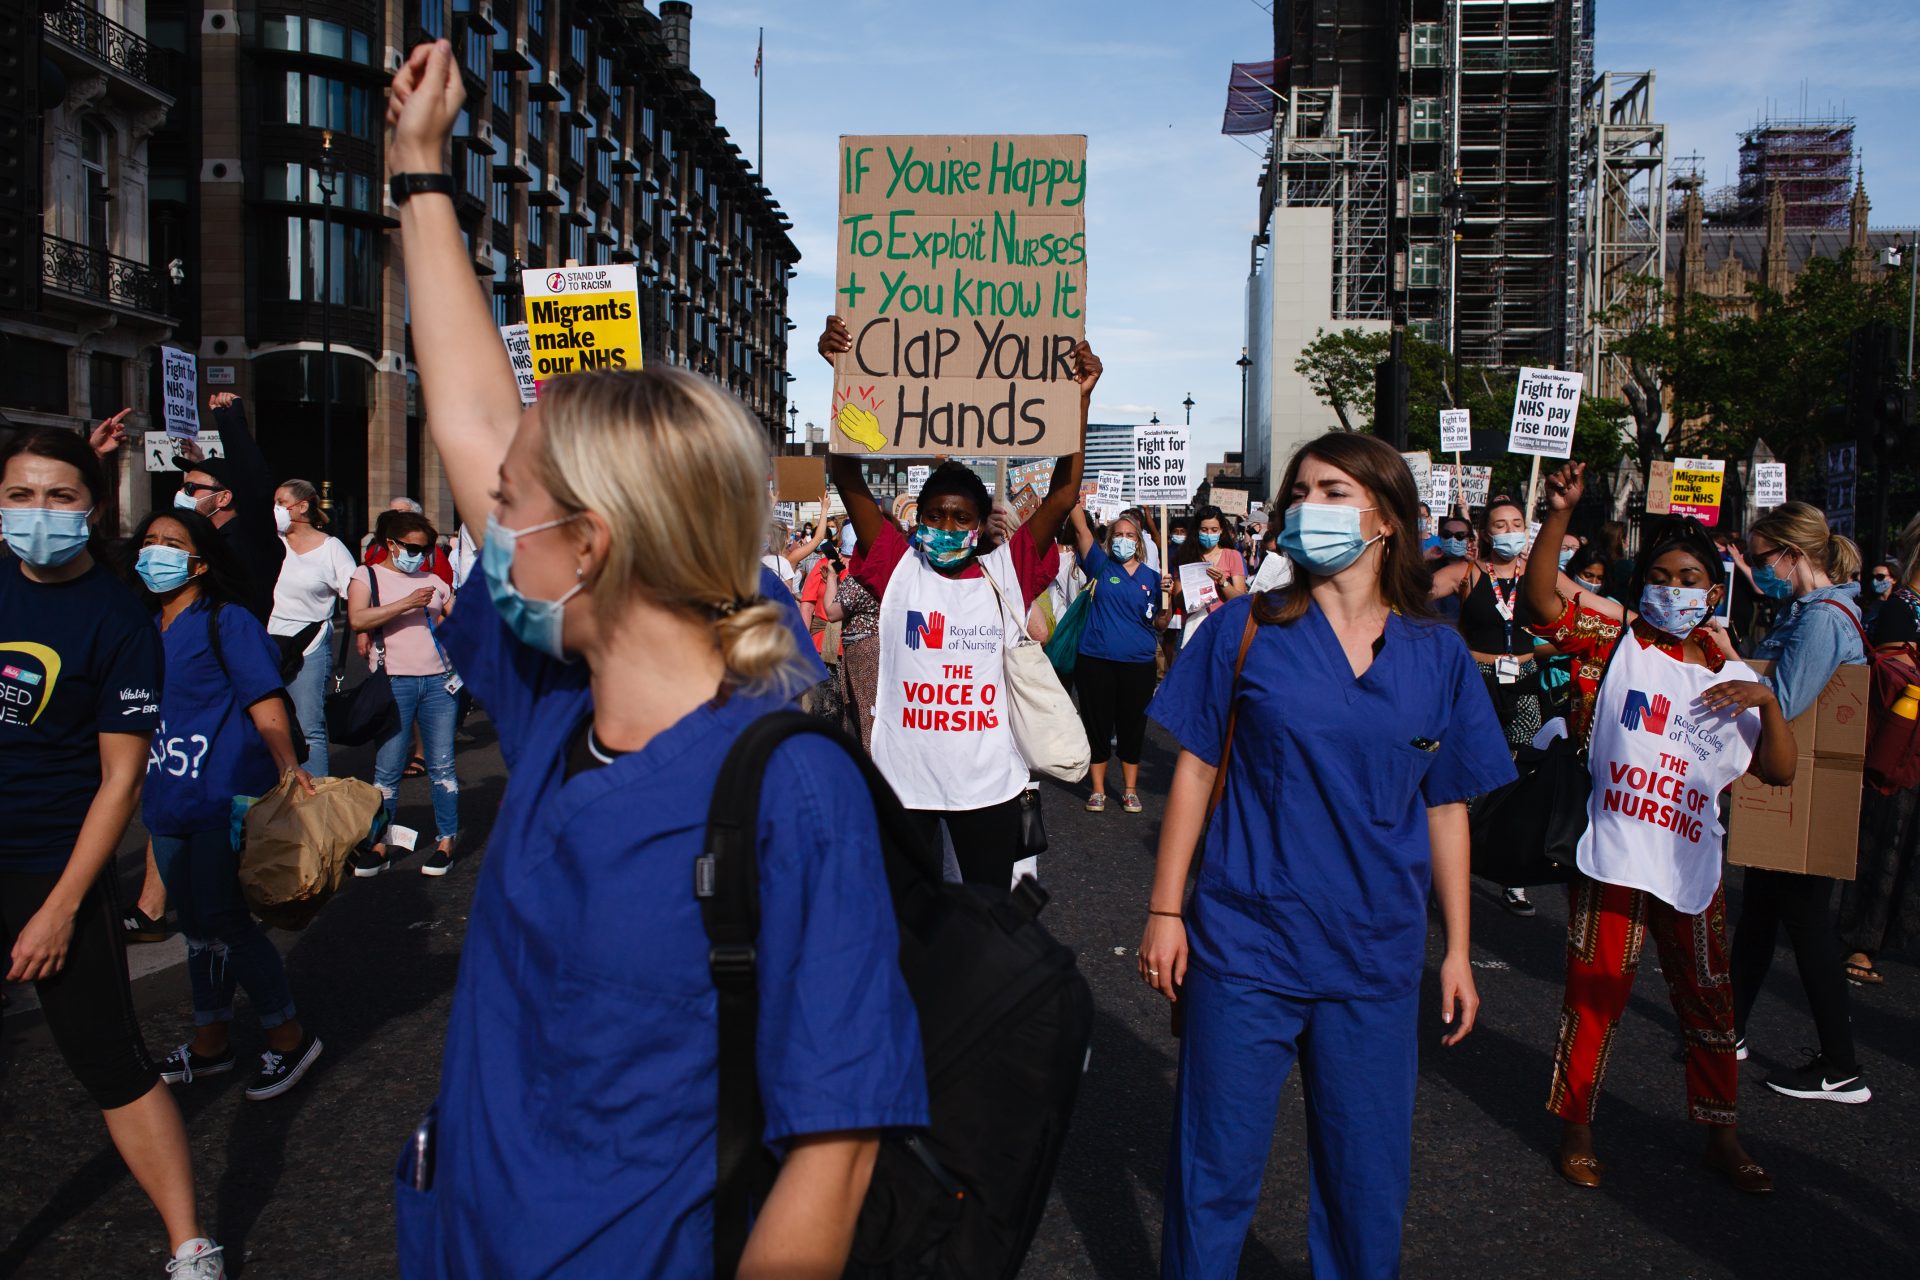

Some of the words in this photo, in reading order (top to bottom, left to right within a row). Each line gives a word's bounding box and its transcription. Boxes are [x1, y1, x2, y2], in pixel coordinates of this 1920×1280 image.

[988, 141, 1086, 207] Happy
[843, 213, 883, 257] To
[886, 210, 986, 269] Exploit
[991, 209, 1086, 266] Nurses
[568, 272, 593, 281] STAND
[595, 271, 607, 280] UP
[569, 282, 579, 290] TO
[582, 280, 612, 290] RACISM
[878, 270, 943, 315] You
[1052, 270, 1081, 318] It
[532, 299, 631, 328] Migrants
[506, 337, 531, 354] Fight
[535, 327, 595, 350] make
[855, 317, 960, 379] Clap
[512, 355, 532, 370] NHS
[538, 357, 574, 374] our
[579, 348, 627, 371] NHS
[166, 359, 187, 380] Fight
[187, 367, 195, 381] for
[518, 371, 535, 385] rise
[166, 381, 184, 399] NHS
[186, 389, 194, 405] ay
[1521, 379, 1553, 400] Fight
[1556, 383, 1576, 400] for
[168, 400, 184, 417] rise
[893, 381, 1046, 449] Hands
[1518, 399, 1545, 417] NHS
[1547, 406, 1571, 423] pay
[1442, 416, 1457, 425] Fight
[1515, 418, 1540, 434] rise
[1543, 424, 1570, 438] now
[1137, 437, 1165, 455] Fight
[1168, 437, 1186, 451] for
[1443, 434, 1454, 442] rise
[1138, 455, 1161, 470] NHS
[1164, 458, 1185, 473] pay
[1099, 476, 1112, 484] Fight
[1138, 472, 1160, 486] rise
[1163, 475, 1187, 486] now
[1438, 478, 1447, 486] for
[1676, 471, 1720, 484] Migrants
[1757, 470, 1773, 479] Fight
[1435, 490, 1446, 498] pay
[1674, 483, 1702, 493] make
[1673, 494, 1690, 502] our
[1692, 494, 1714, 503] NHS
[782, 510, 793, 518] now
[1672, 504, 1685, 512] Stop
[950, 625, 977, 639] Royal
[948, 639, 960, 650] of
[962, 640, 997, 653] Nursing
[942, 664, 973, 679] THE
[120, 688, 150, 701] Vitality
[902, 681, 973, 706] VOICE
[980, 683, 997, 706] O
[142, 704, 160, 714] BR
[902, 707, 999, 732] NURSING
[1674, 714, 1699, 737] Royal
[1669, 731, 1683, 741] of
[1659, 752, 1689, 777] THE
[1609, 761, 1685, 805] VOICE
[1686, 788, 1709, 816] OF
[1603, 788, 1704, 844] NURSING
